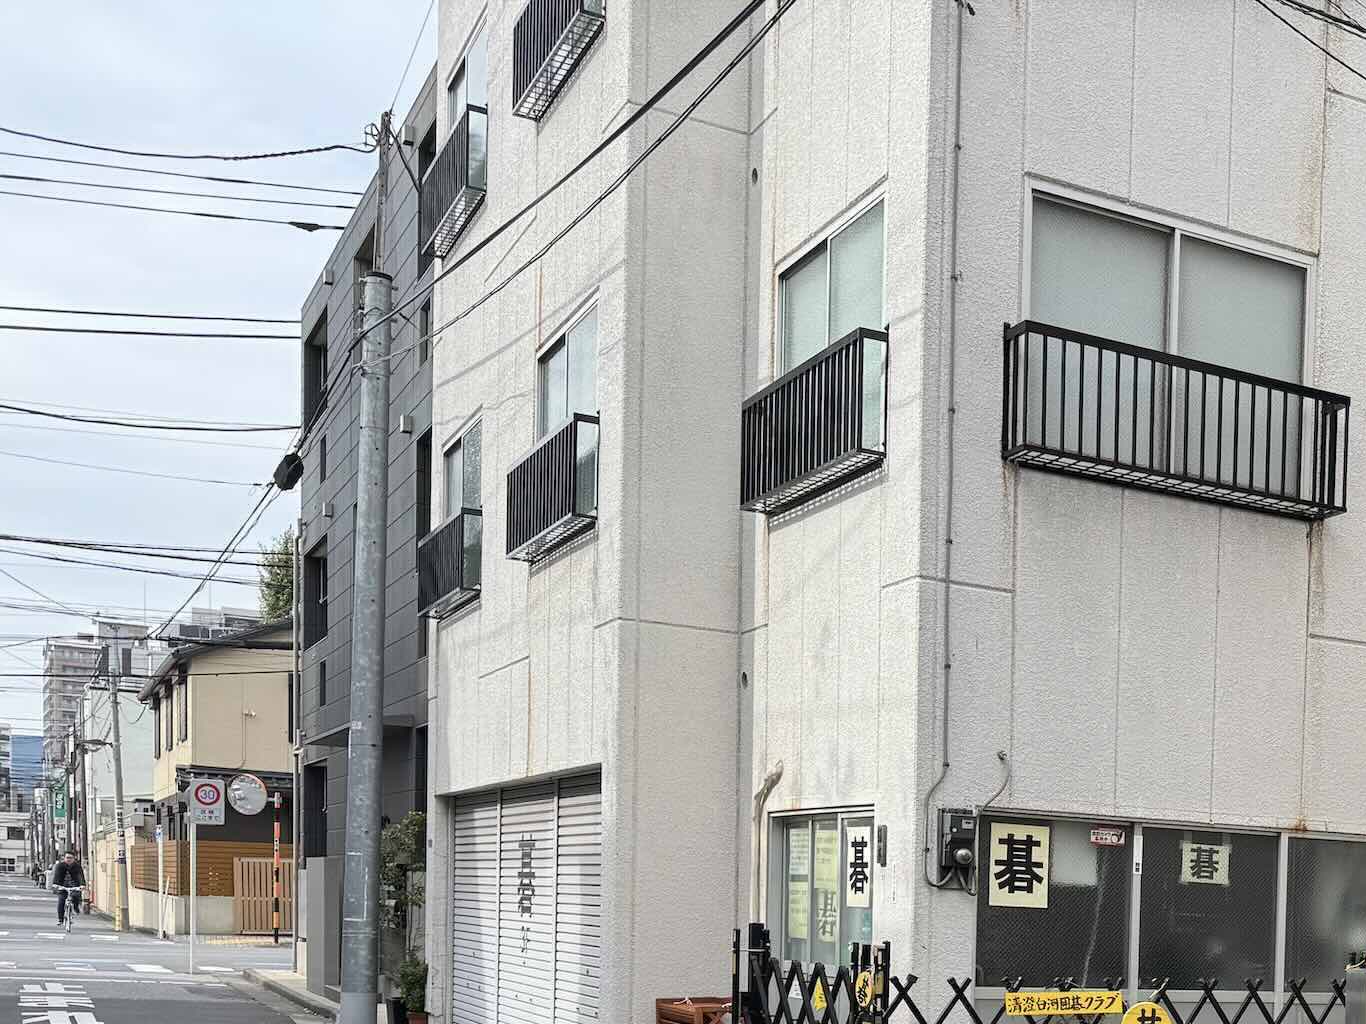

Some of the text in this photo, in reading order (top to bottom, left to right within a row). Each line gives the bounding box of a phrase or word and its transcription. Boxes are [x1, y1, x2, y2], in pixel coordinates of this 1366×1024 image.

[200, 790, 215, 800] 30
[849, 836, 869, 895] 碁
[994, 833, 1044, 894] 碁
[1190, 846, 1219, 881] 碁
[1007, 993, 1120, 1013] 清澄白河囲碁クラブ
